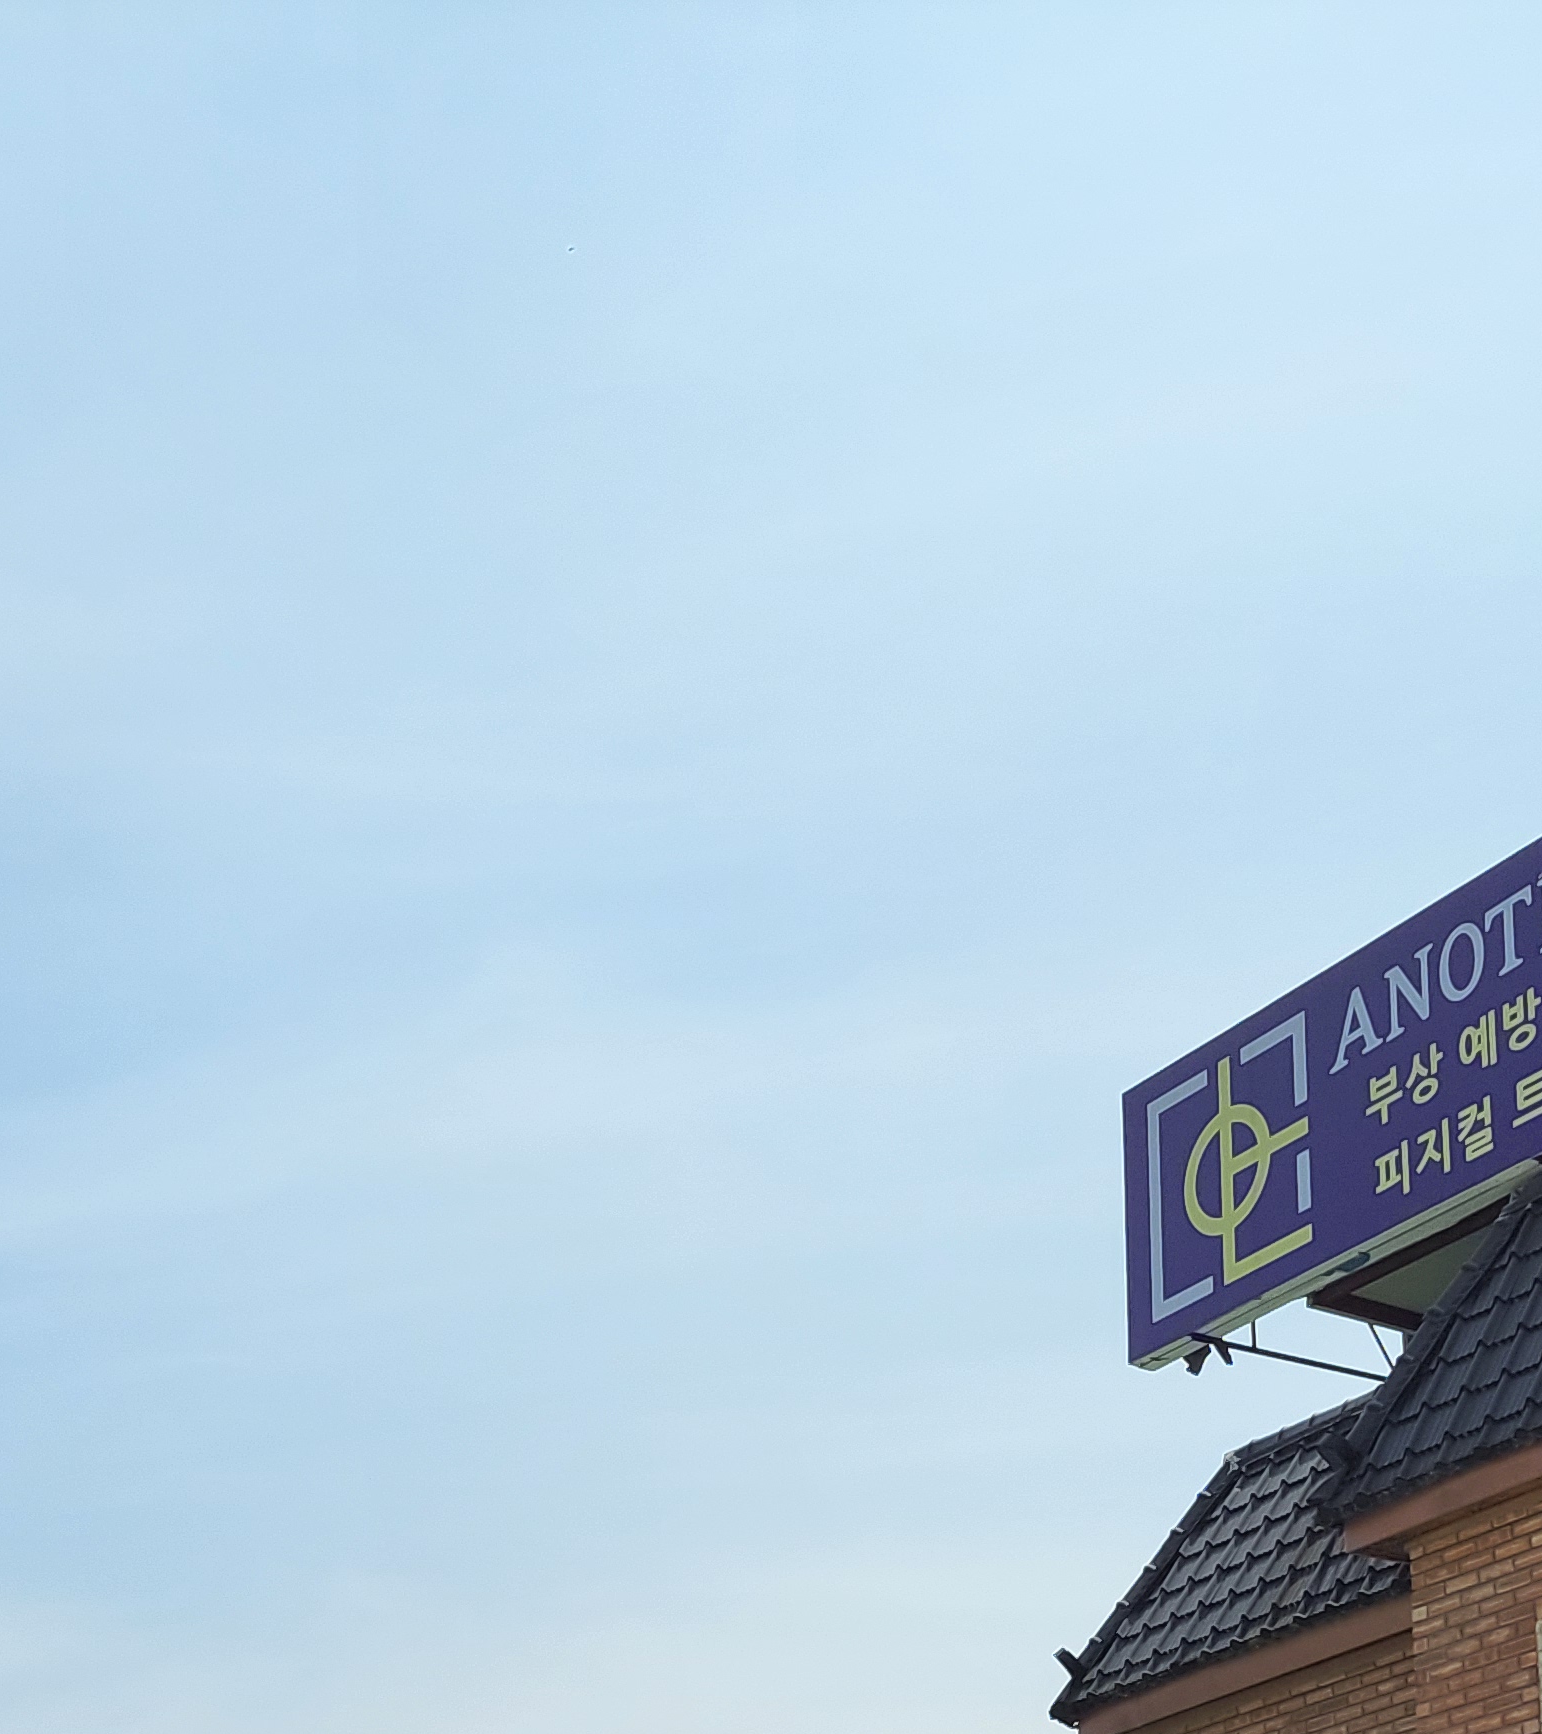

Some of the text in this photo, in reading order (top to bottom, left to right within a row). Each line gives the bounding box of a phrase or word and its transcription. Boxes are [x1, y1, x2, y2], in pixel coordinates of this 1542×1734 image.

[1365, 1042, 1444, 1125] 부상
[1457, 987, 1542, 1070] 예방
[1374, 1094, 1495, 1195] 피지컬
